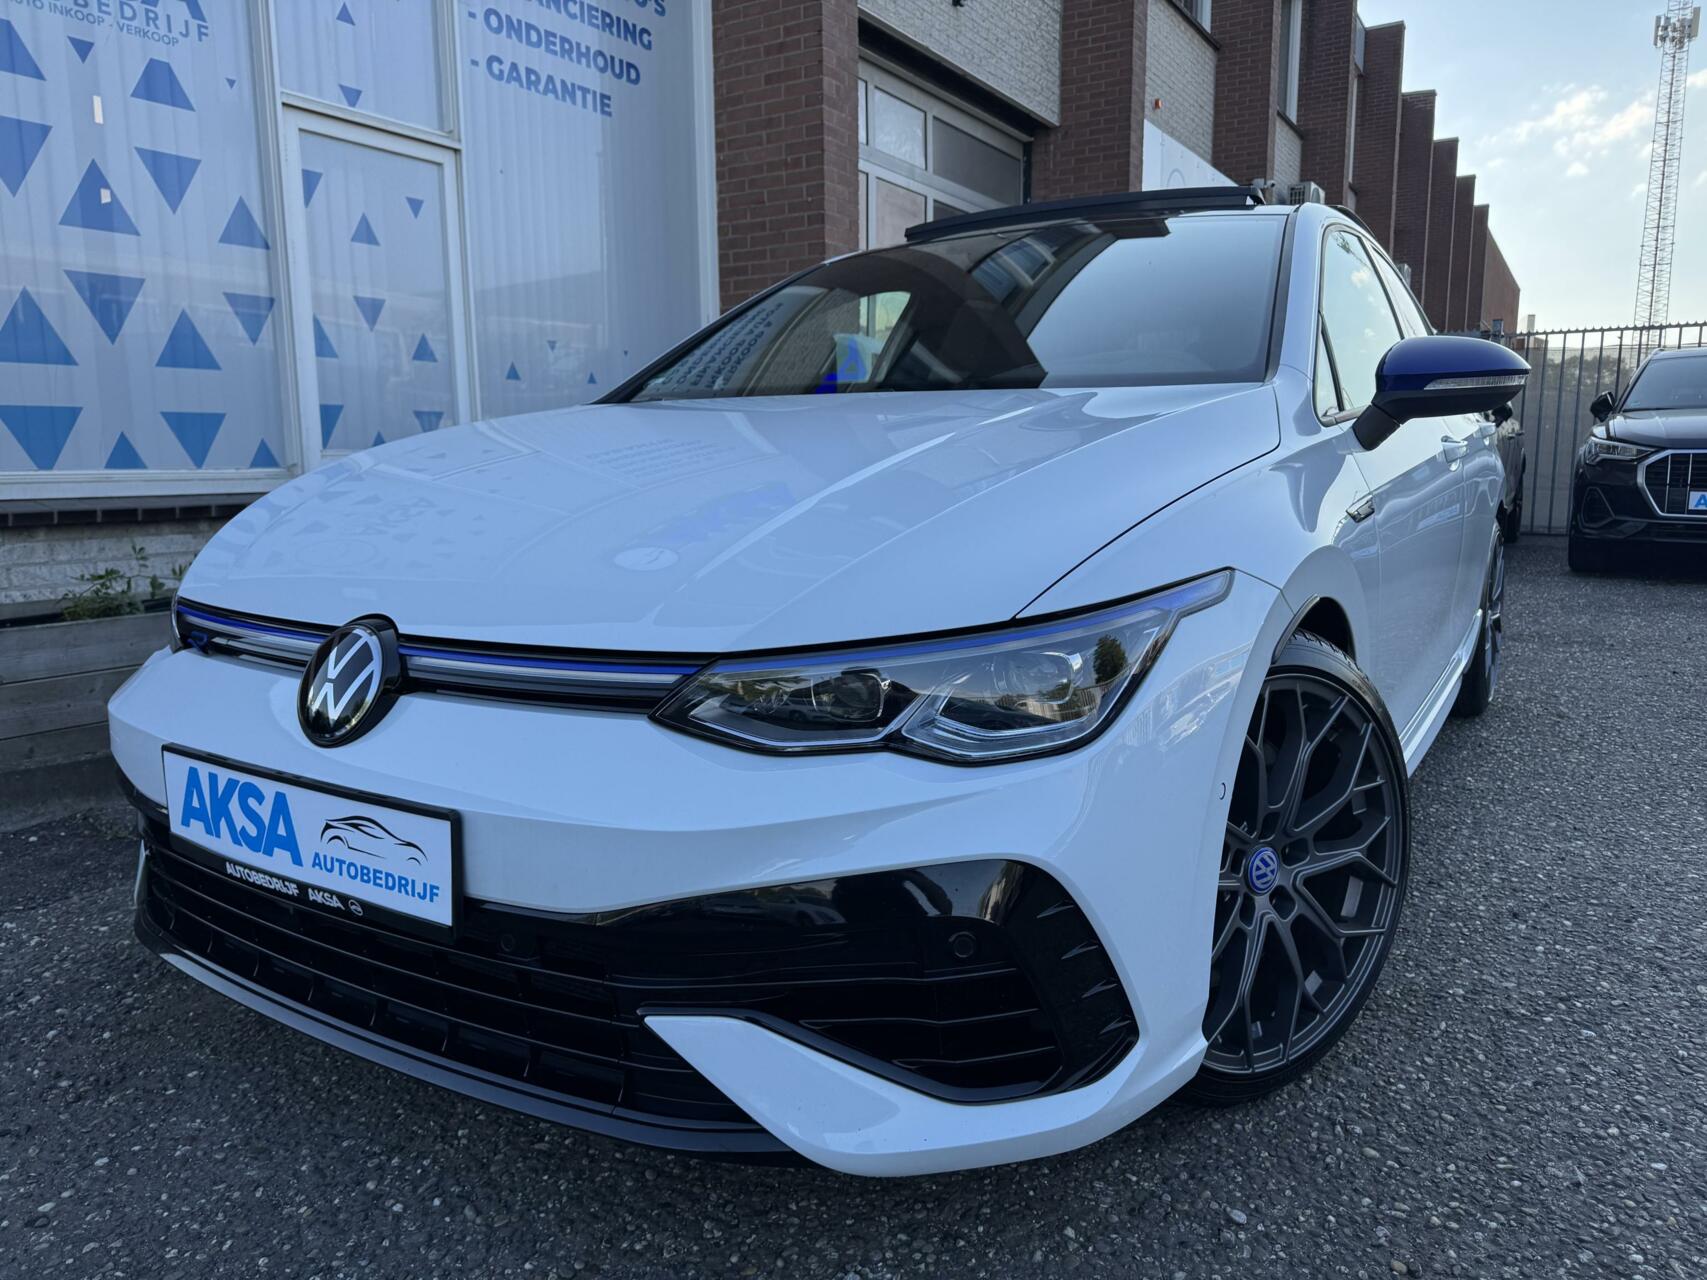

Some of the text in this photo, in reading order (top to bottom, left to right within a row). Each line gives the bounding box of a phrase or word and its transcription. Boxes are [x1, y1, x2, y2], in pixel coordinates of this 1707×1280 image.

[48, 1, 105, 26] INKOOP
[116, 20, 180, 47] VERKOOP
[483, 7, 641, 86] ONDERHOUD
[486, 54, 613, 118] GARANTIE
[181, 766, 304, 868] AKSA
[225, 861, 346, 911] AUTOBEDRIJF AKSA
[311, 851, 441, 904] AUTOBEDRIJF
